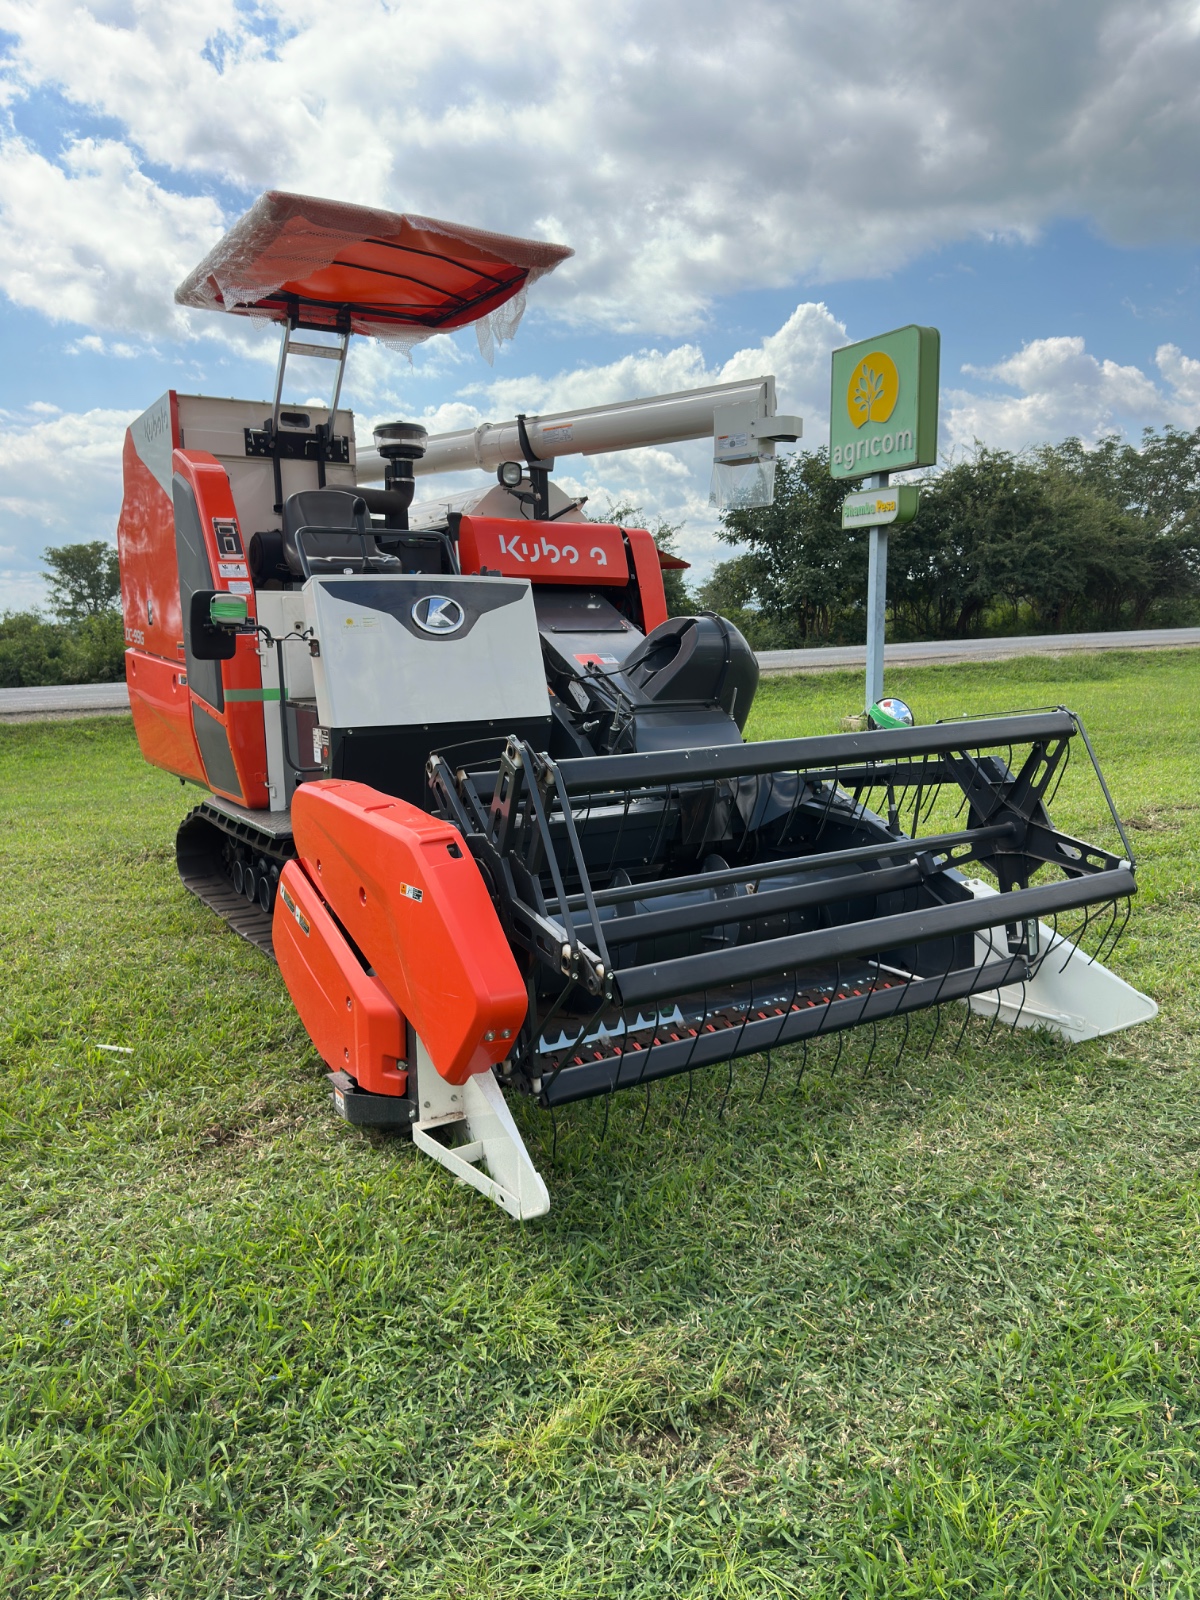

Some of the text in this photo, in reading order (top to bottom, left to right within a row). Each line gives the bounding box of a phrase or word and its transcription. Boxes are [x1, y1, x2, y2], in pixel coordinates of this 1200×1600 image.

[833, 429, 913, 470] agricom
[844, 499, 896, 518] Shamba Pesa
